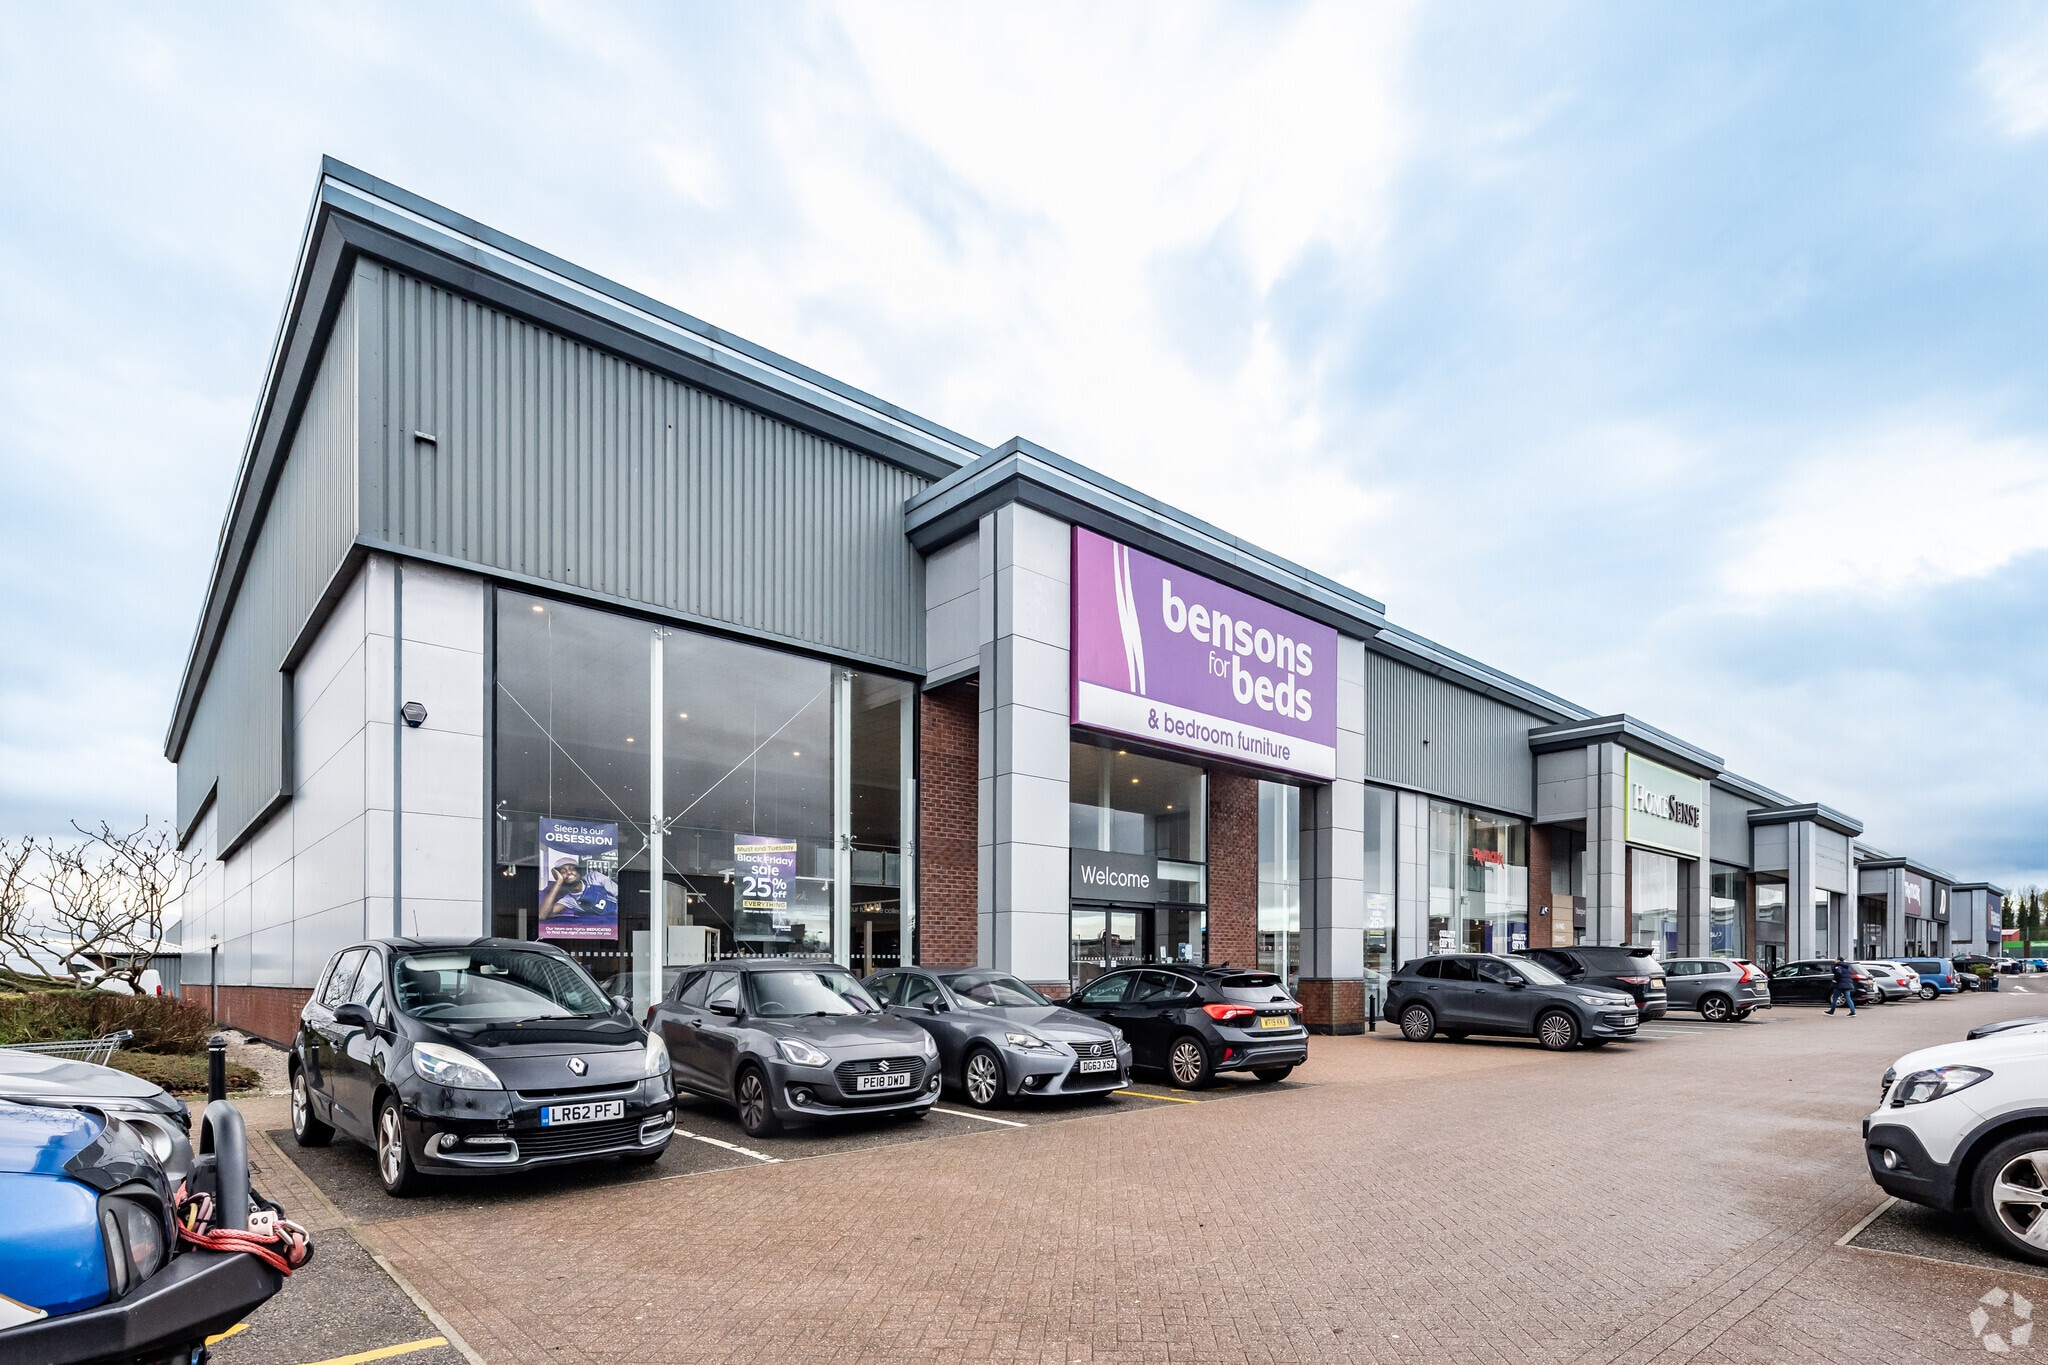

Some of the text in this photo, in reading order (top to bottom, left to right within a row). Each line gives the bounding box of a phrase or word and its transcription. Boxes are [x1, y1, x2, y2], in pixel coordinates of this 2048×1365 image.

[1162, 578, 1313, 677] bensons
[1209, 650, 1313, 722] for beds
[1148, 708, 1291, 760] & bedroom furniture
[554, 824, 579, 834] Sleep
[545, 832, 613, 845] OBSESSION
[737, 853, 794, 867] Black Friday
[1081, 865, 1150, 889] Welcome
[1083, 1060, 1115, 1071] DG63 XSZ
[863, 1076, 885, 1088] PE18
[552, 1103, 621, 1122] LR62 PFJ
